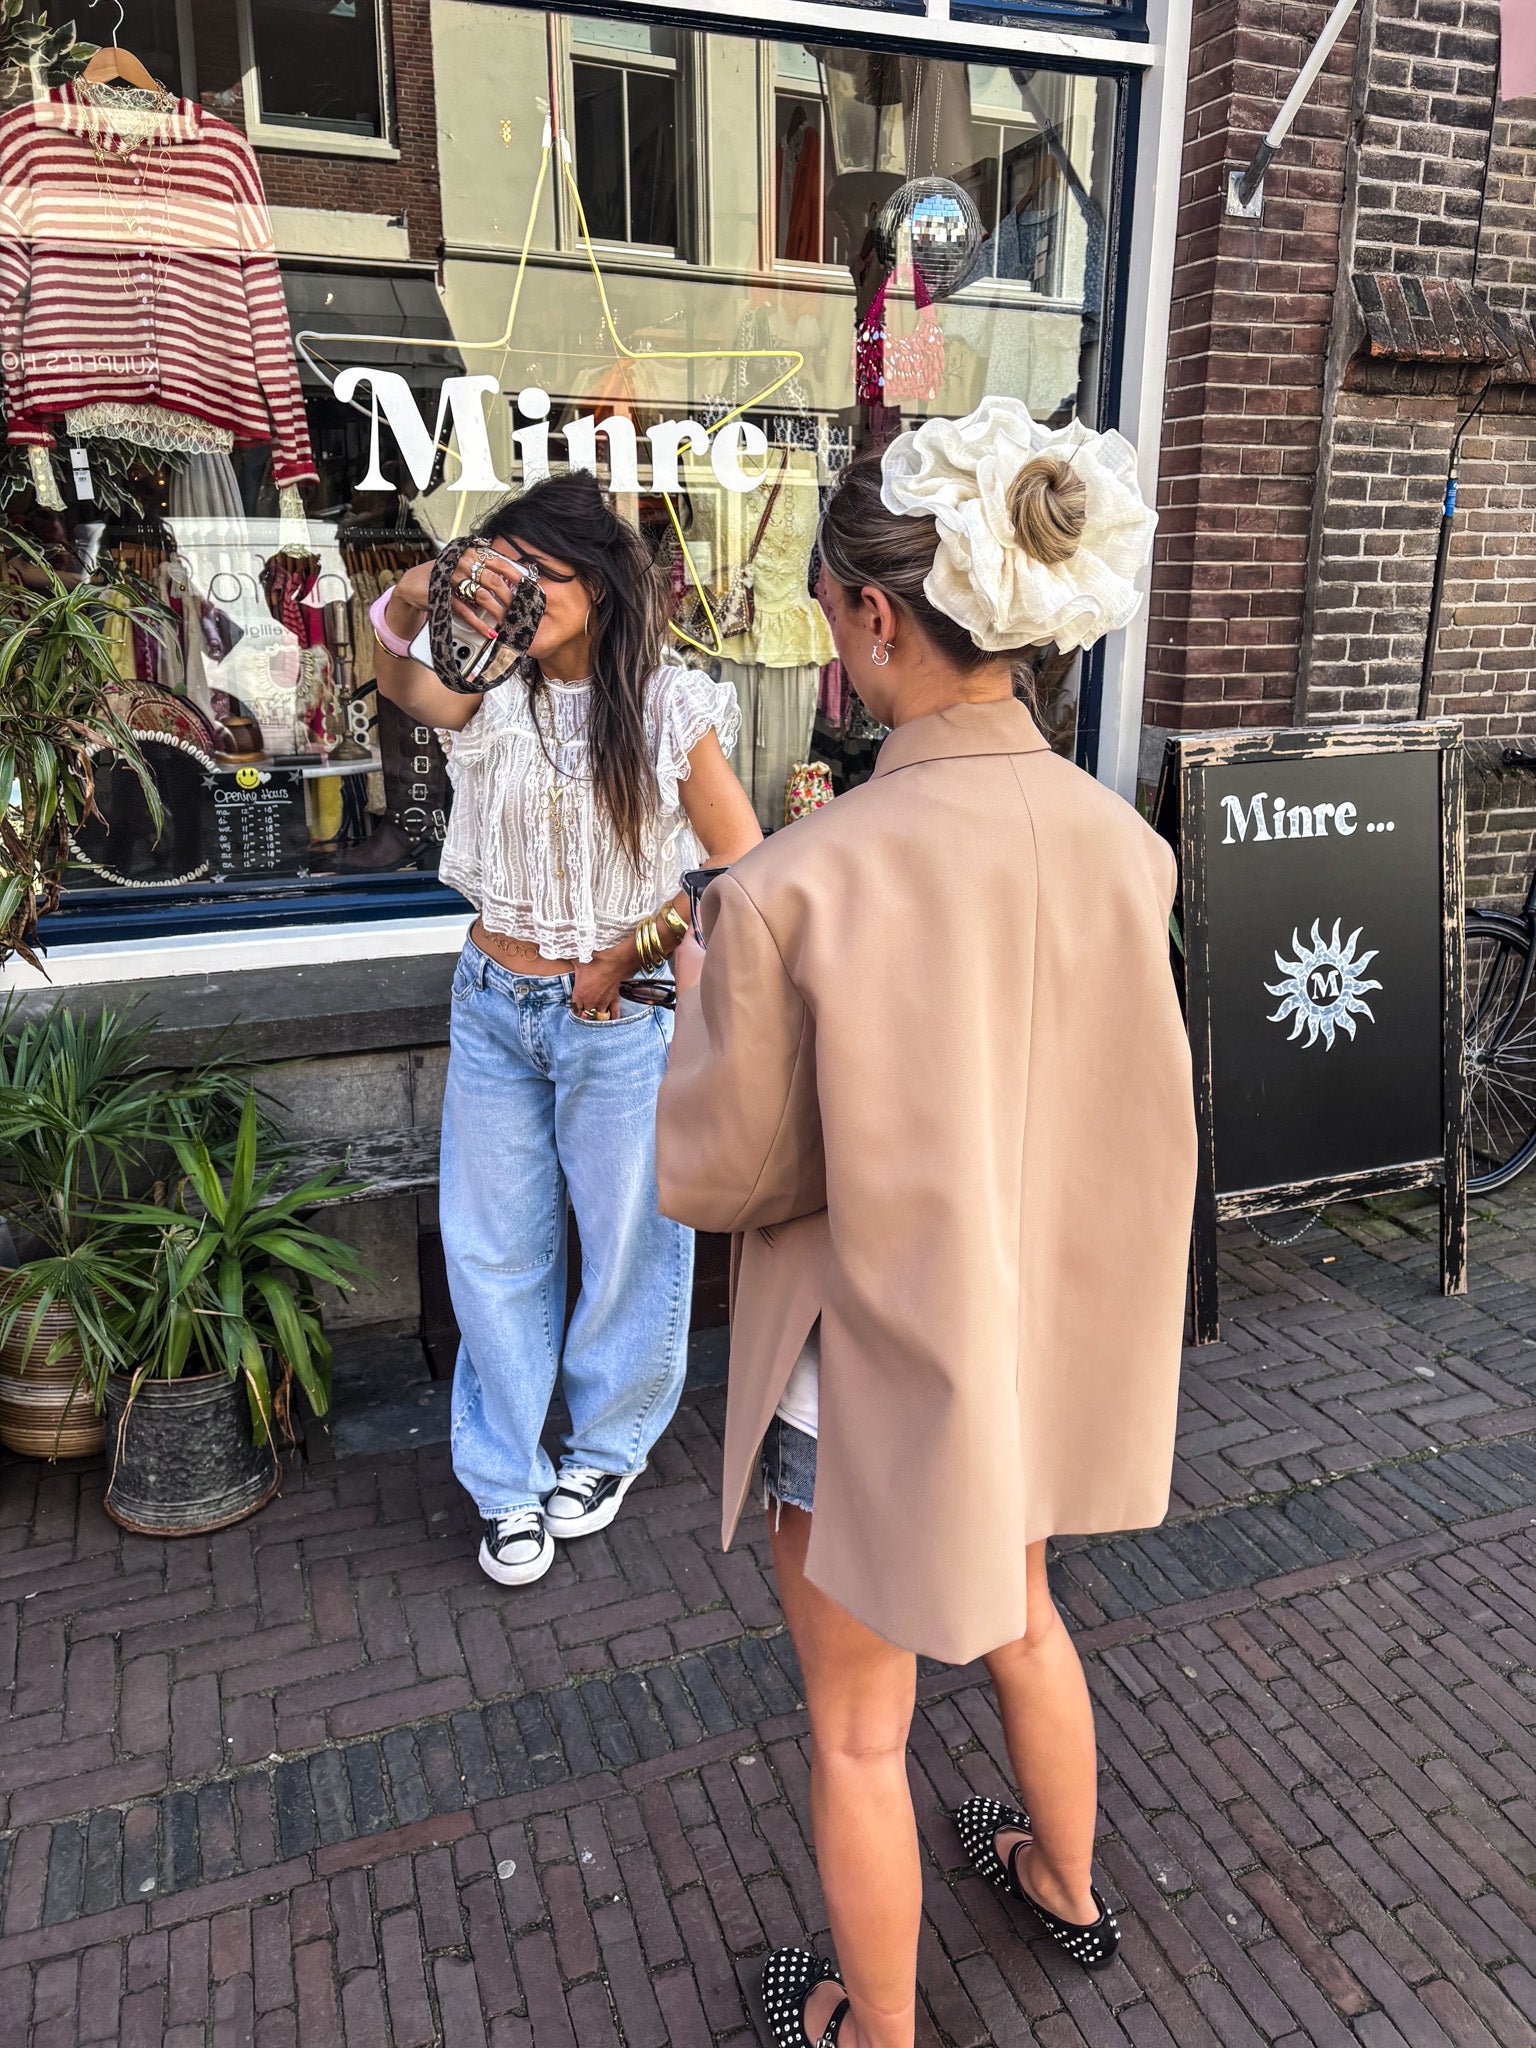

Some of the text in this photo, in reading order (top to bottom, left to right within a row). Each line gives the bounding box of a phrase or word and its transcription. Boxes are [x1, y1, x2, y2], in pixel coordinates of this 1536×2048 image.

[333, 366, 770, 493] Minre
[214, 788, 289, 805] Opening Hours
[1220, 792, 1358, 845] Minre
[1311, 969, 1341, 1000] M
